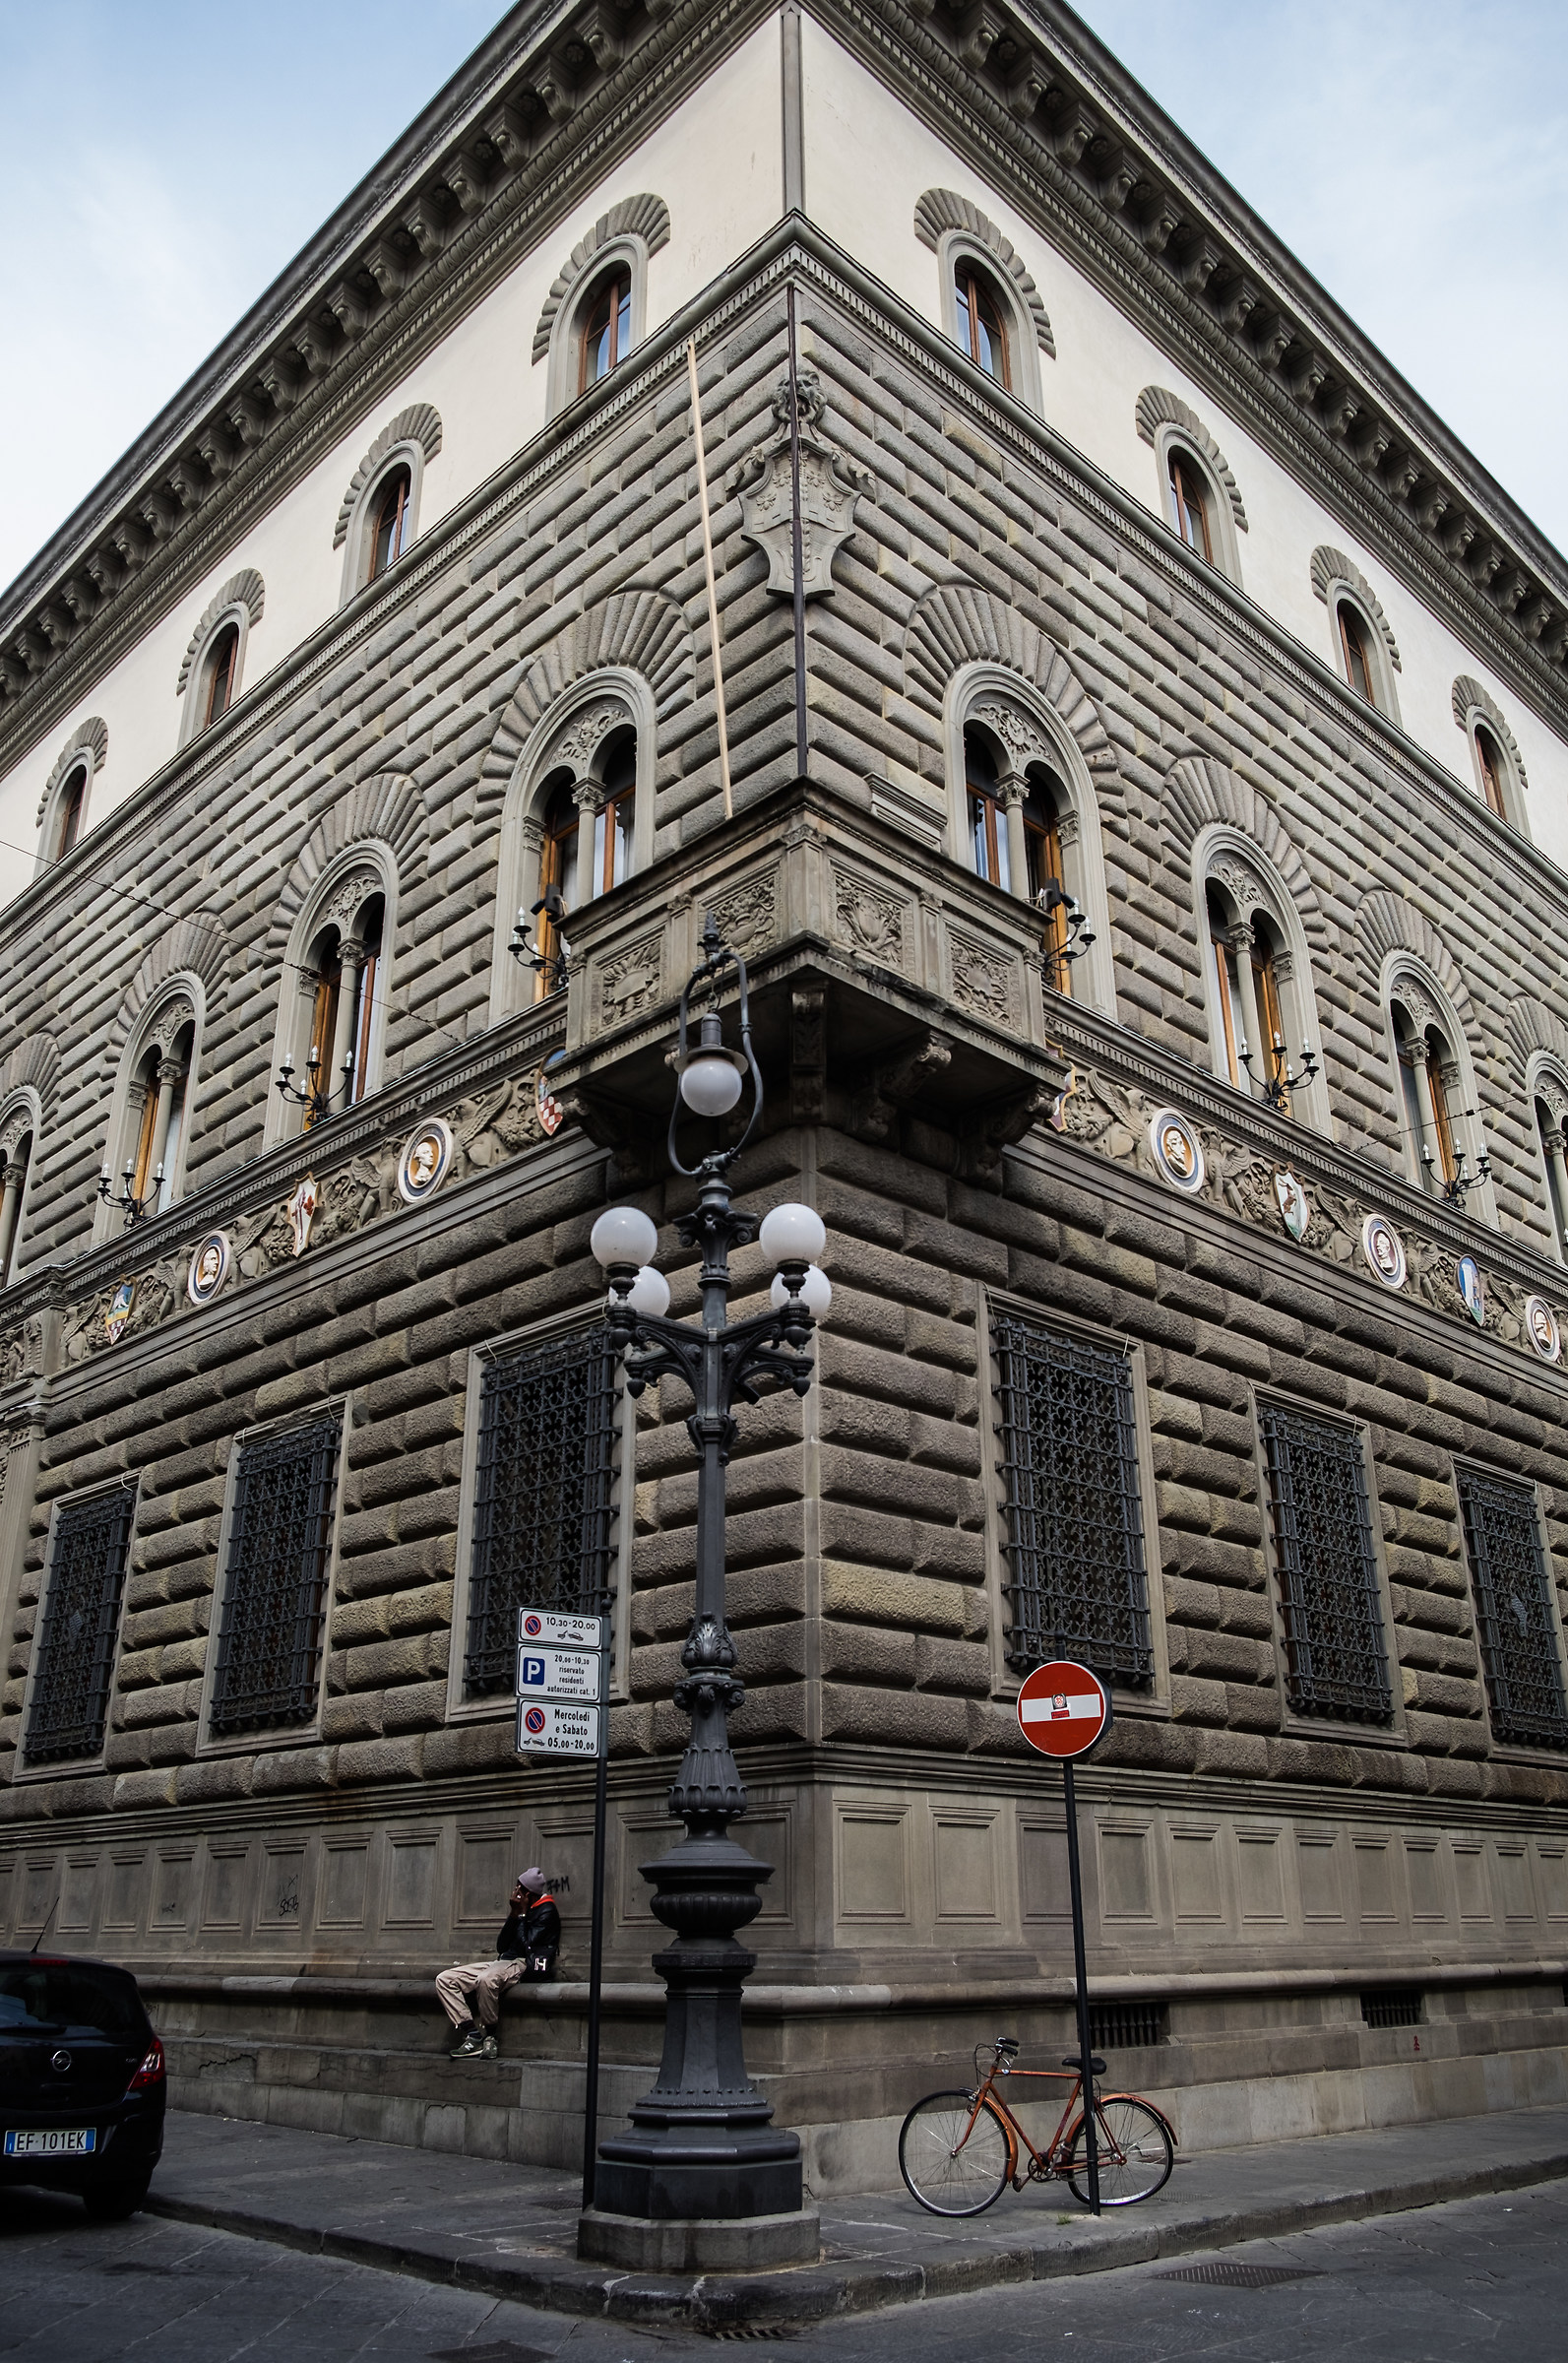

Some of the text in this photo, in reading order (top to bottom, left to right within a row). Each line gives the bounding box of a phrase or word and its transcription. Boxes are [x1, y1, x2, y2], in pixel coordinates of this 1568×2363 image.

[527, 1660, 540, 1682] P
[559, 1665, 585, 1675] riservato
[559, 1676, 585, 1685] residenti
[546, 1686, 578, 1694] autorizzati
[562, 1723, 588, 1736] Sabato
